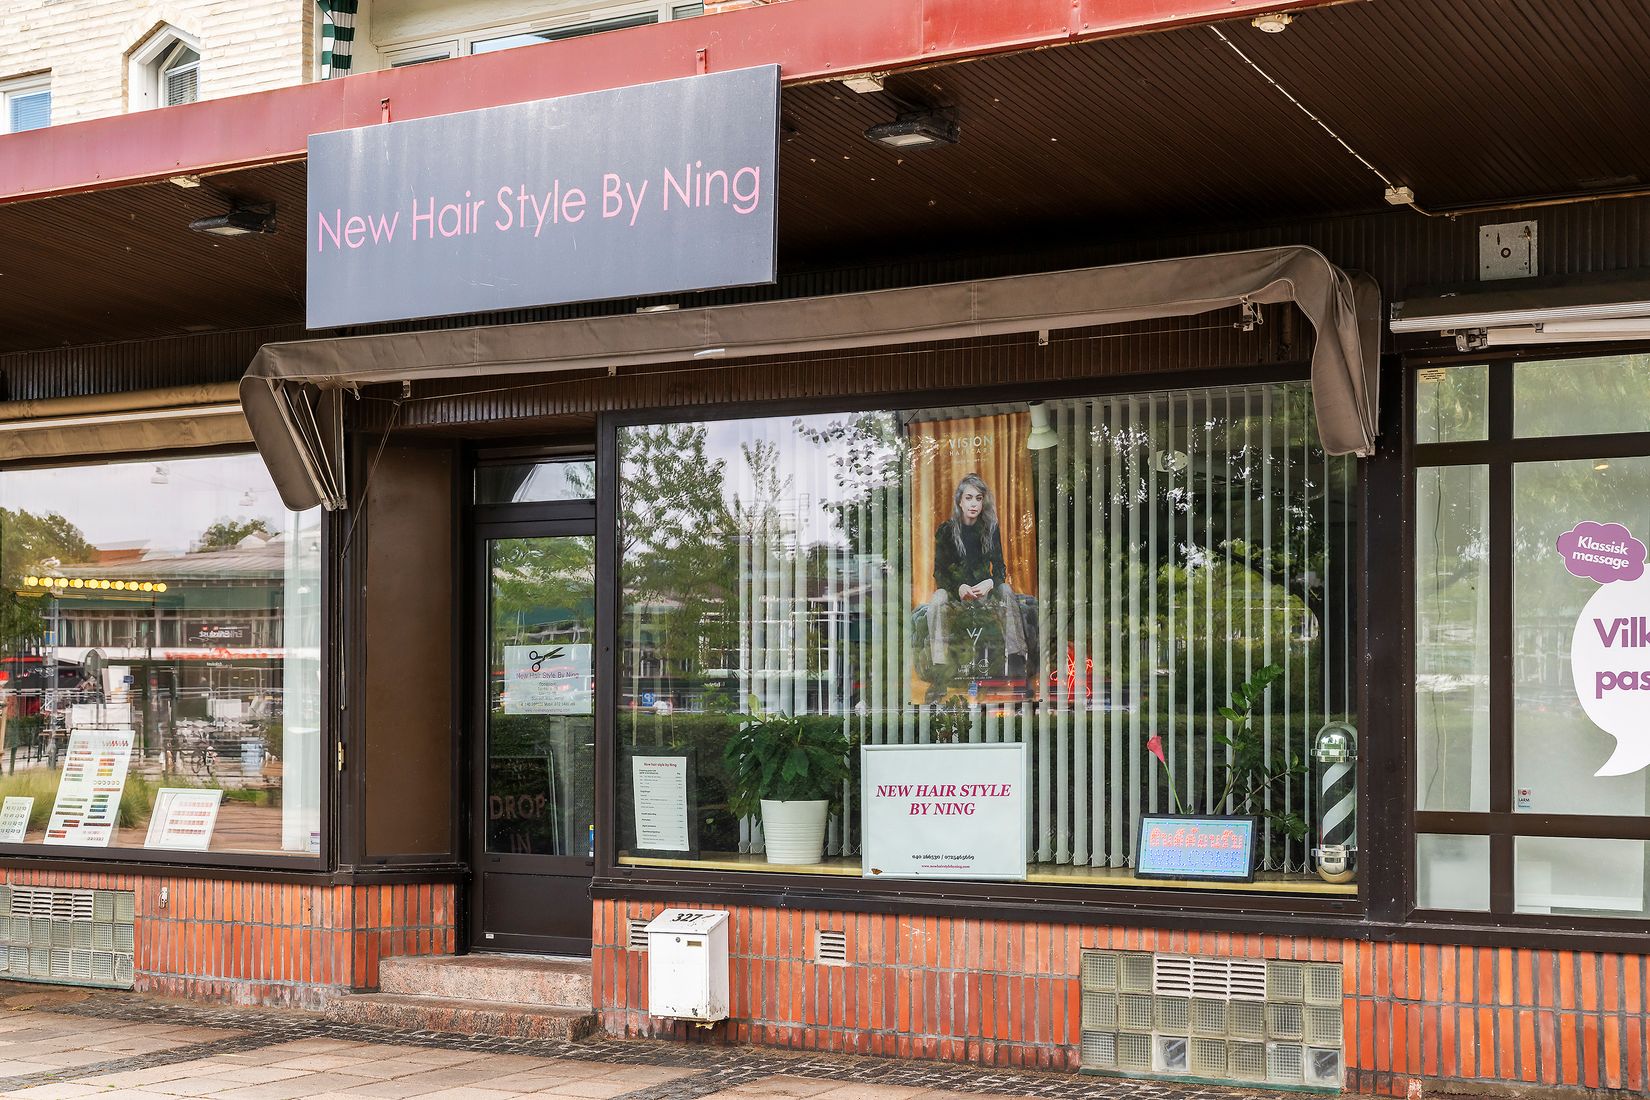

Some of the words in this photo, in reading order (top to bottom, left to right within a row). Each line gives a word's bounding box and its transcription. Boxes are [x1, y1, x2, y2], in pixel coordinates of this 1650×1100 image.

[318, 208, 399, 252] New
[411, 189, 485, 241] Hair
[495, 179, 586, 238] Style
[602, 173, 648, 226] By
[662, 160, 761, 215] Ning
[948, 434, 993, 449] VISION
[1577, 535, 1629, 555] Klassisk
[1572, 550, 1630, 570] massage
[1593, 616, 1650, 648] Vilk
[566, 671, 580, 679] Ning
[1595, 670, 1650, 699] pas
[876, 784, 913, 797] NEW
[915, 784, 956, 797] HAIR
[959, 784, 1012, 797] STYLE
[489, 794, 545, 819] DROP
[909, 803, 932, 816] BY
[933, 803, 976, 816] NING
[511, 833, 531, 853] IN
[1149, 848, 1240, 868] WELCOME
[672, 913, 703, 923] 327
